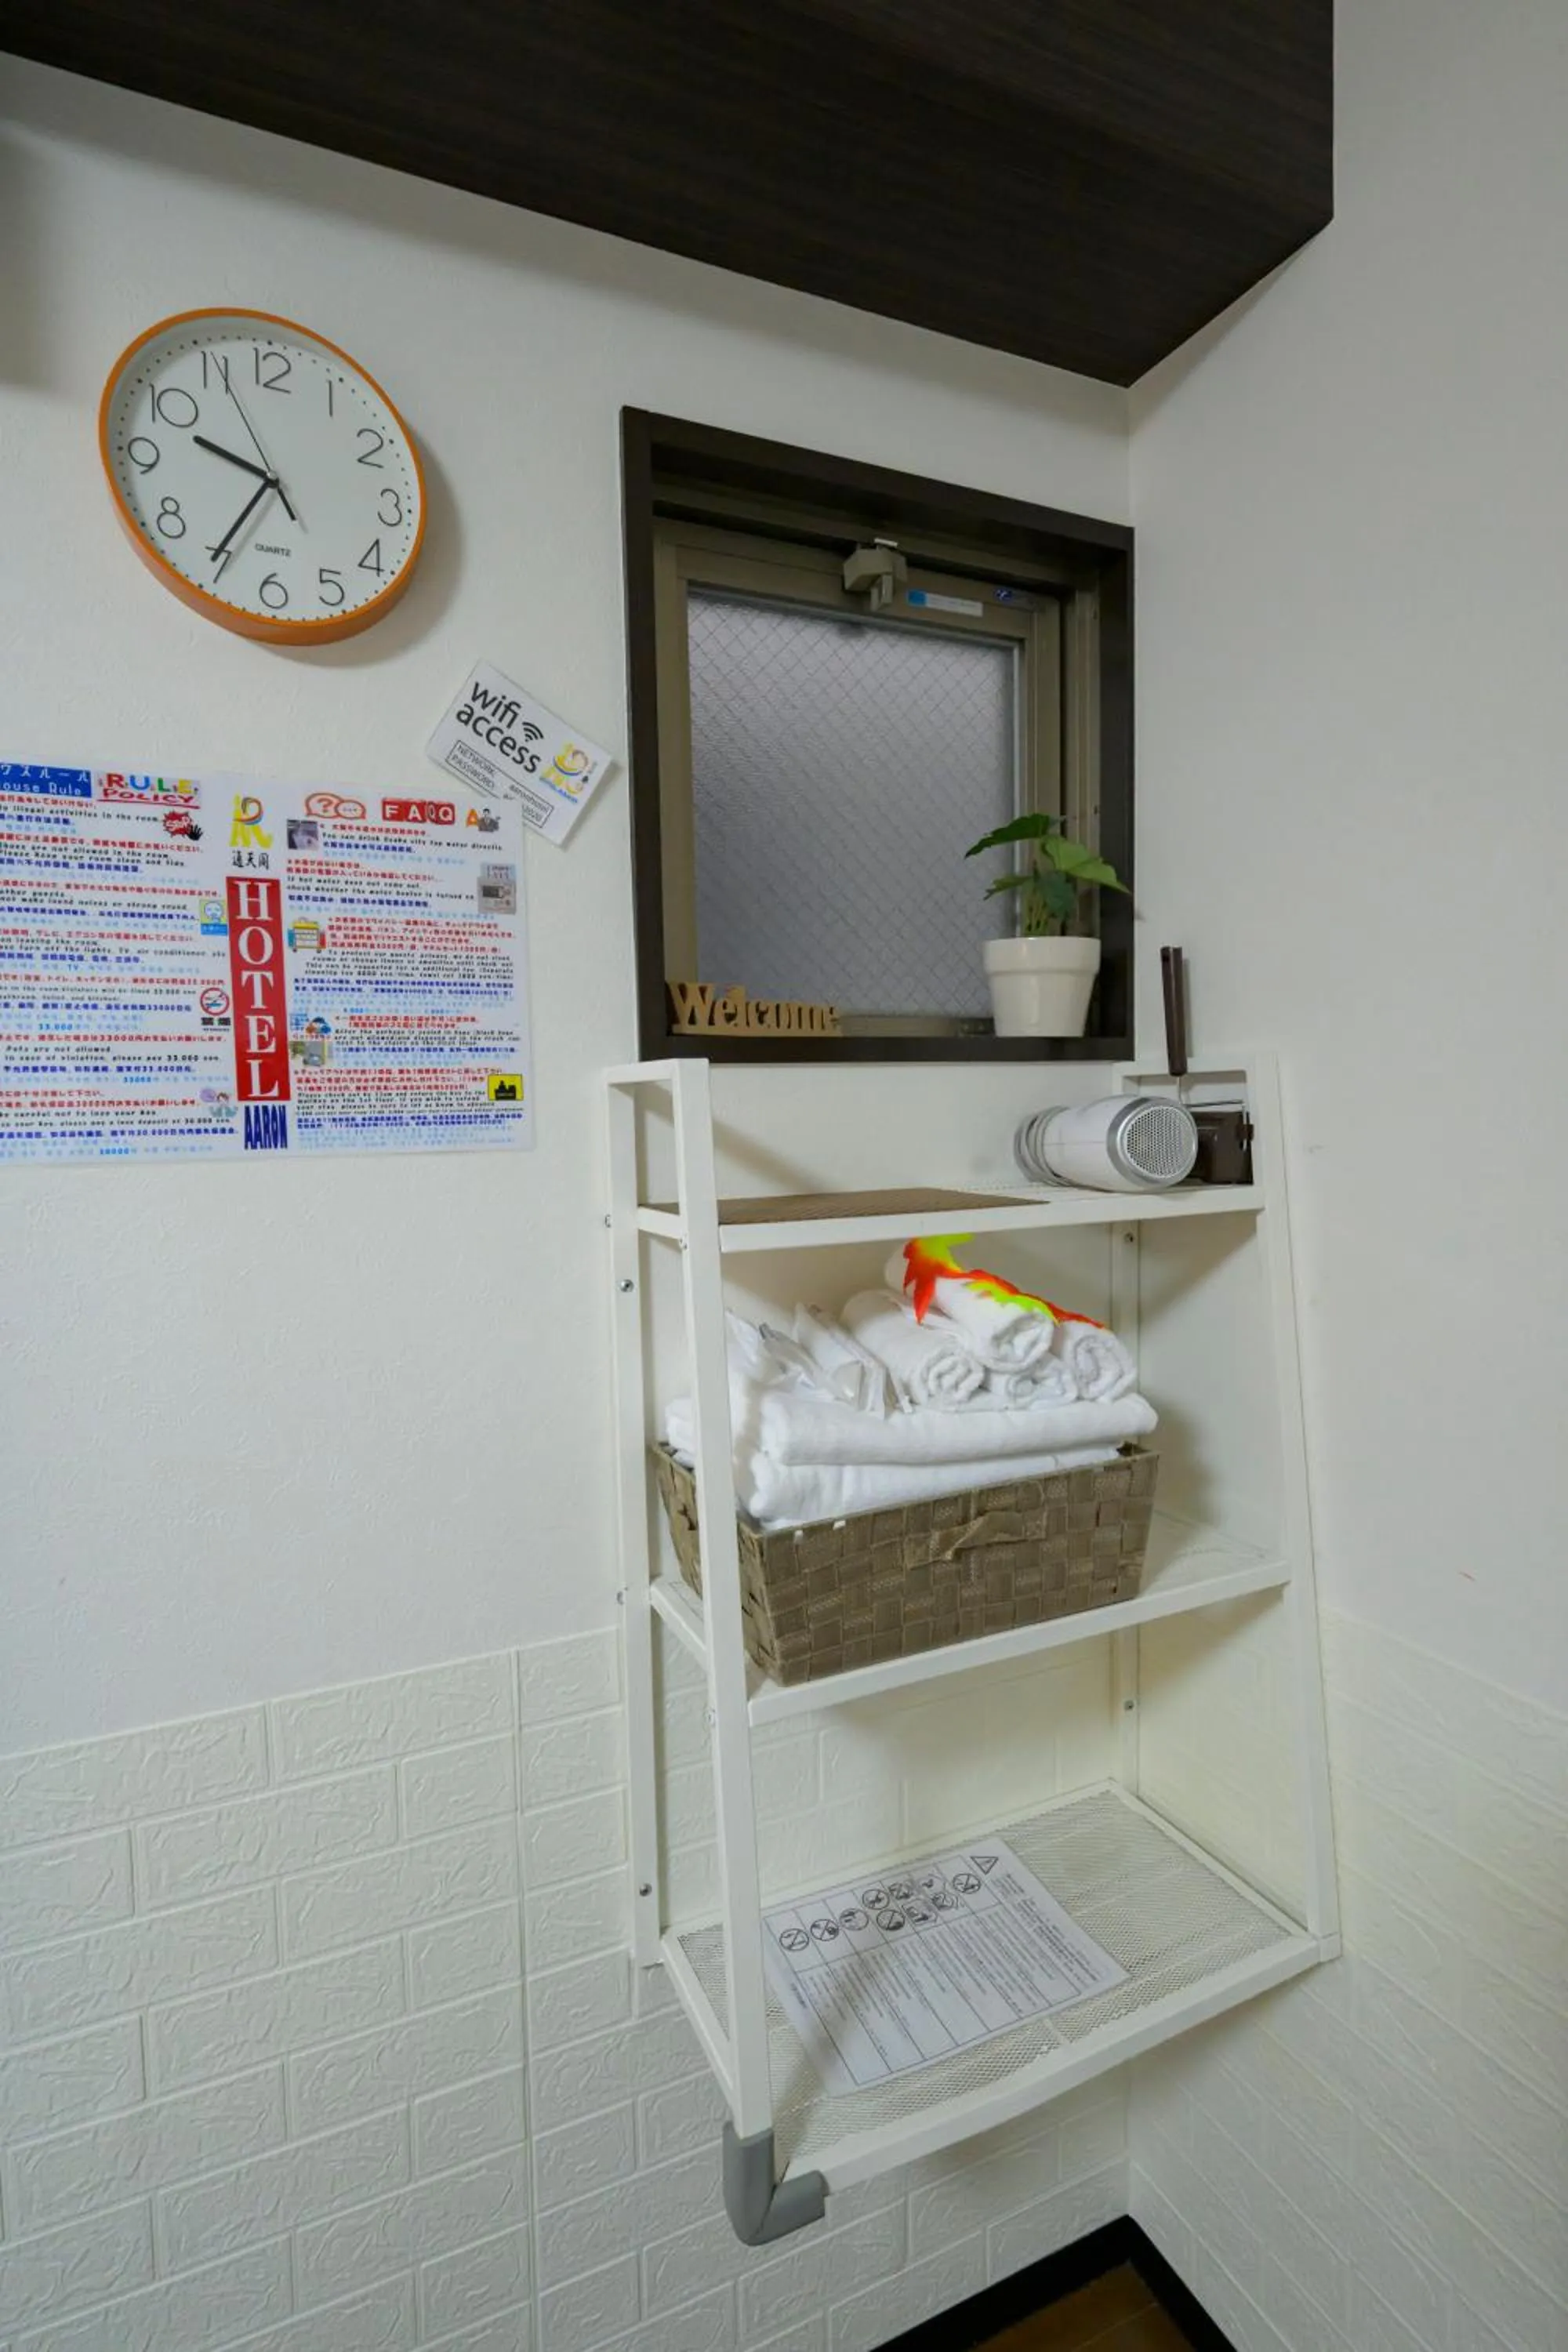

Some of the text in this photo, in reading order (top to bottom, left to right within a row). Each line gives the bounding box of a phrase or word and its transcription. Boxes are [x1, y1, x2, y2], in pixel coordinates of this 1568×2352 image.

[201, 351, 229, 394] 11
[253, 347, 292, 394] 12
[150, 383, 199, 428] 10
[127, 437, 160, 474] 9
[357, 428, 384, 469] 2
[157, 496, 186, 539] 8
[378, 488, 402, 527] 3
[205, 546, 233, 583] 7
[255, 543, 292, 557] QUARTZ
[358, 539, 385, 577] 4
[259, 573, 289, 608] 6
[318, 568, 345, 606] 5
[470, 681, 521, 728] wifi
[456, 703, 542, 774] access
[49, 782, 82, 796] Rule
[103, 788, 194, 804] POLICY
[234, 880, 279, 1098] HOTEL
[244, 1105, 288, 1150] AARON
